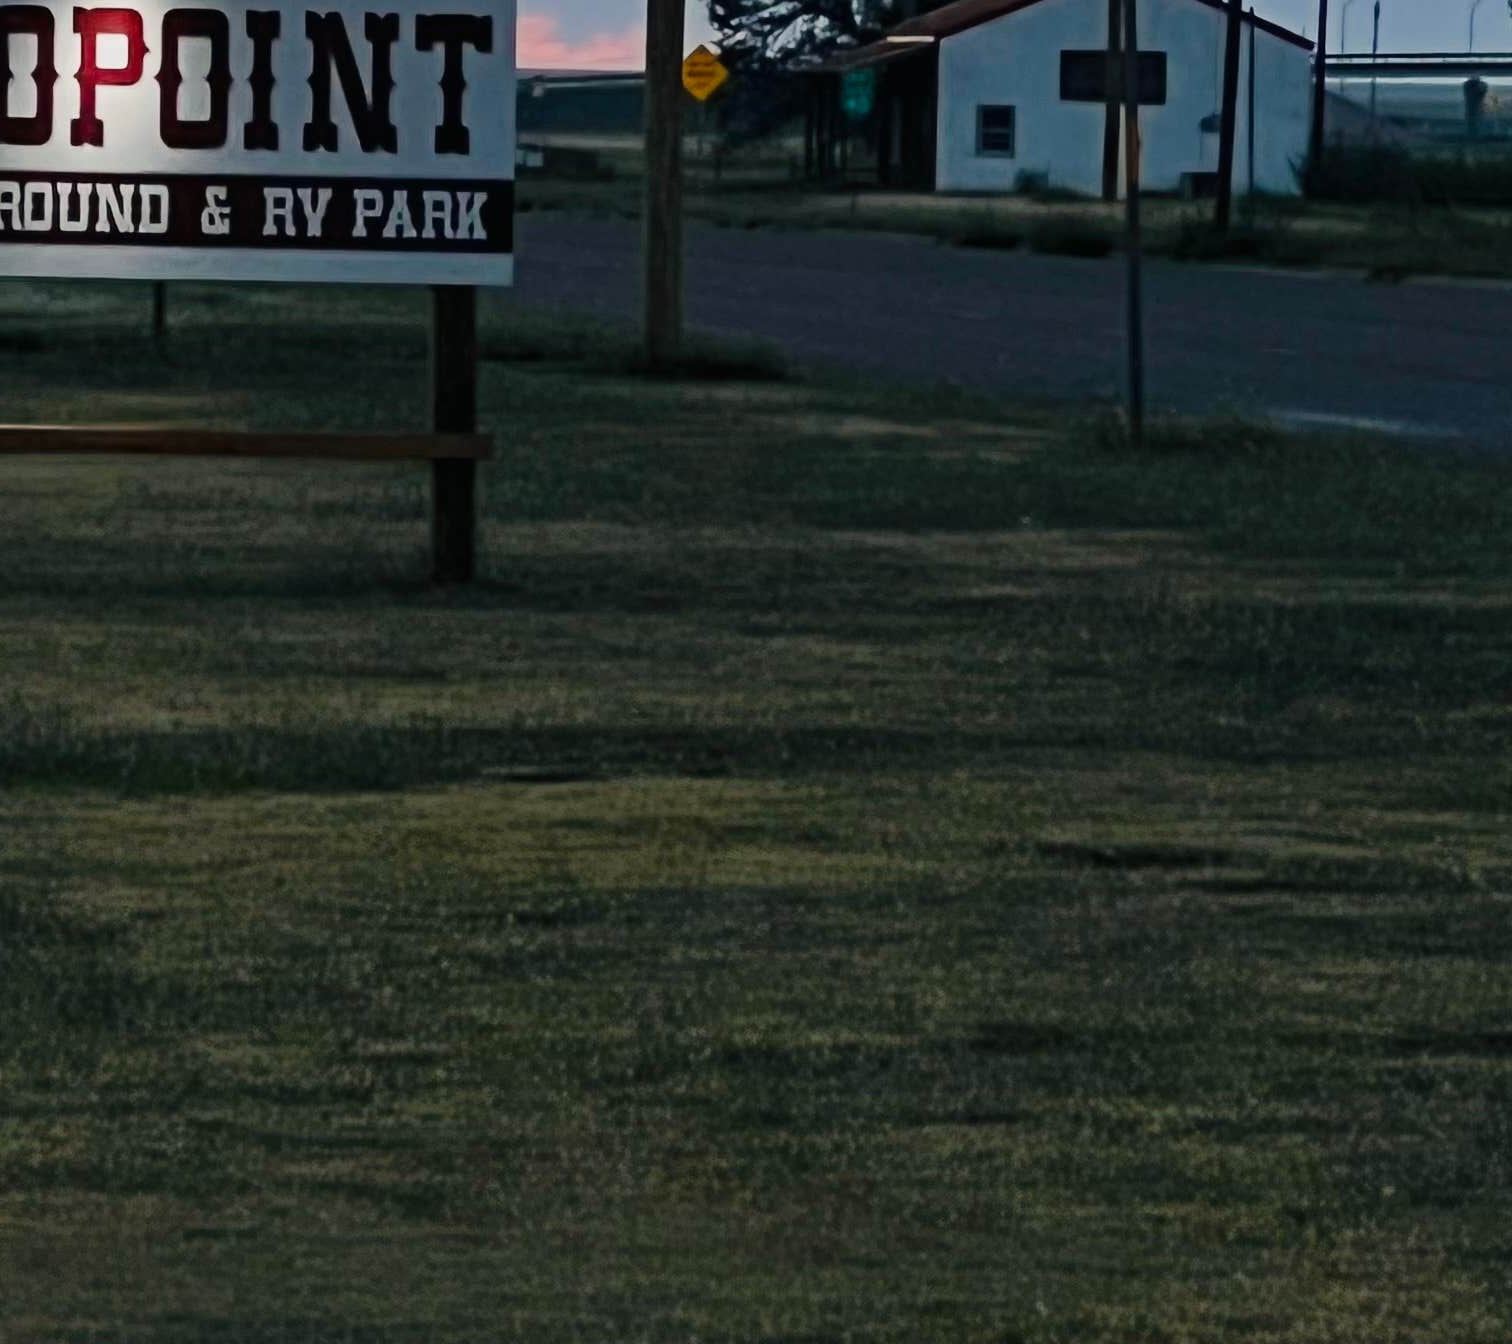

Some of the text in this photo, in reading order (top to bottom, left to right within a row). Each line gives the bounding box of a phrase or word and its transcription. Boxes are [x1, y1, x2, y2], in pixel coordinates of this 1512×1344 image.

[201, 186, 231, 236] &
[262, 187, 334, 239] RV
[353, 188, 489, 241] PARK
